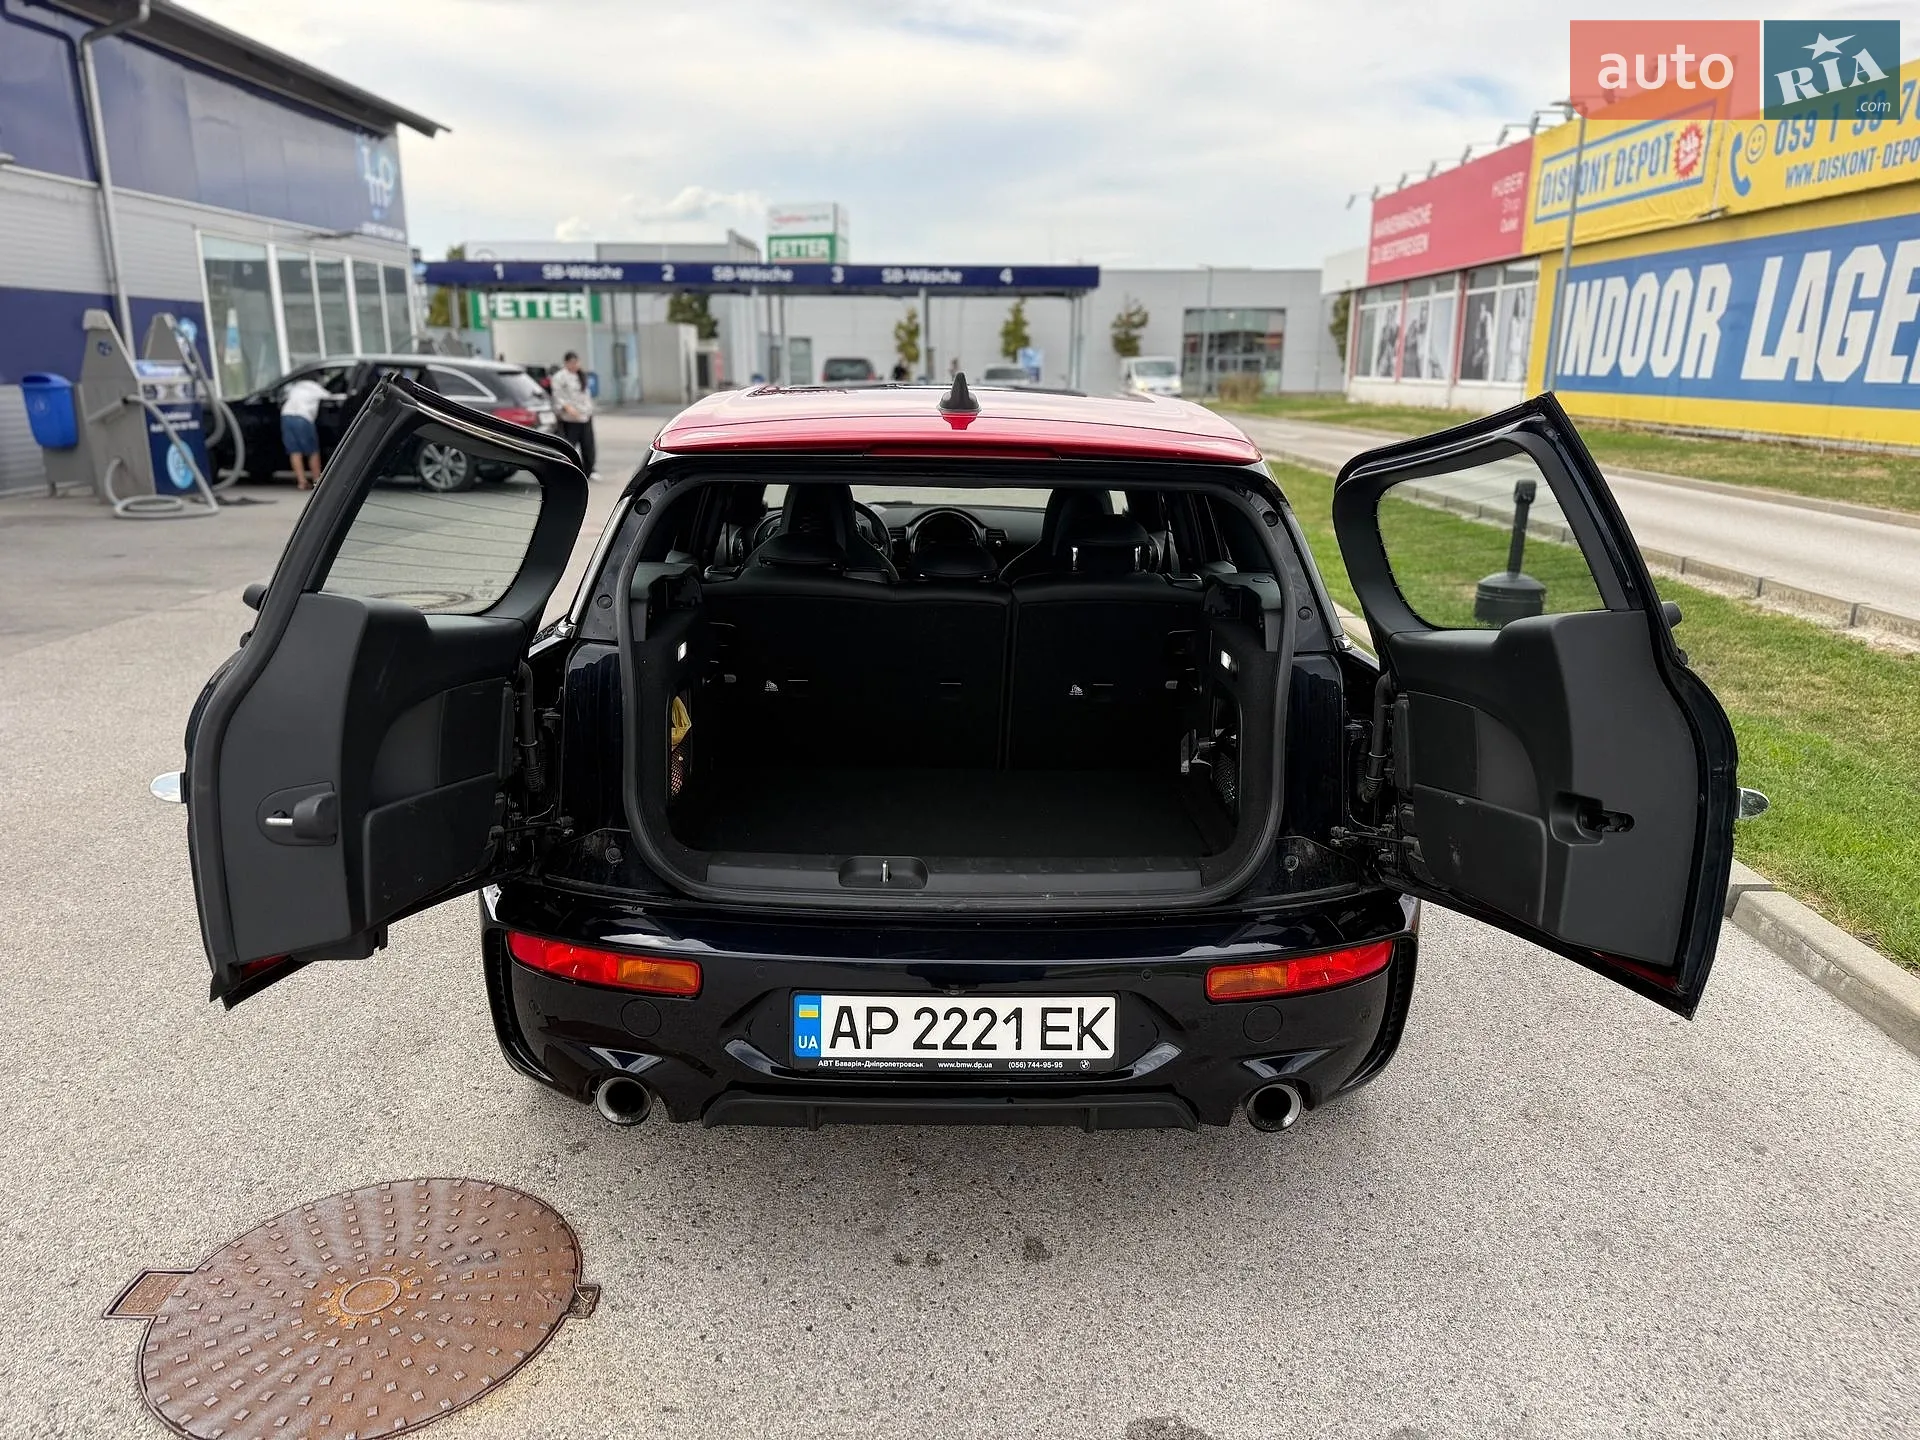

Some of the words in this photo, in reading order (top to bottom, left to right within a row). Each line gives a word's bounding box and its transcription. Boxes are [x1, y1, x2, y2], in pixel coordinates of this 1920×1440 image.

[1614, 131, 1675, 188] DEPOT
[770, 238, 829, 259] FETTER
[493, 263, 505, 280] 1
[541, 263, 624, 281] SB-Wäsche
[661, 264, 675, 282] 2
[712, 265, 794, 283] SB-Wäsche
[832, 266, 845, 284] 3
[881, 267, 963, 285] SB-Wäsche
[1000, 267, 1013, 285] 4
[477, 292, 588, 318] FETTER
[1556, 263, 1732, 380] INDOOR
[1740, 239, 1920, 385] LAGE
[829, 1005, 899, 1050] AP
[912, 1006, 1023, 1051] 2221
[1040, 1006, 1111, 1051] EK
[798, 1035, 819, 1049] UA
[937, 1061, 993, 1069] www.bmw.dp.ua
[1027, 1061, 1064, 1069] 744-95-95
